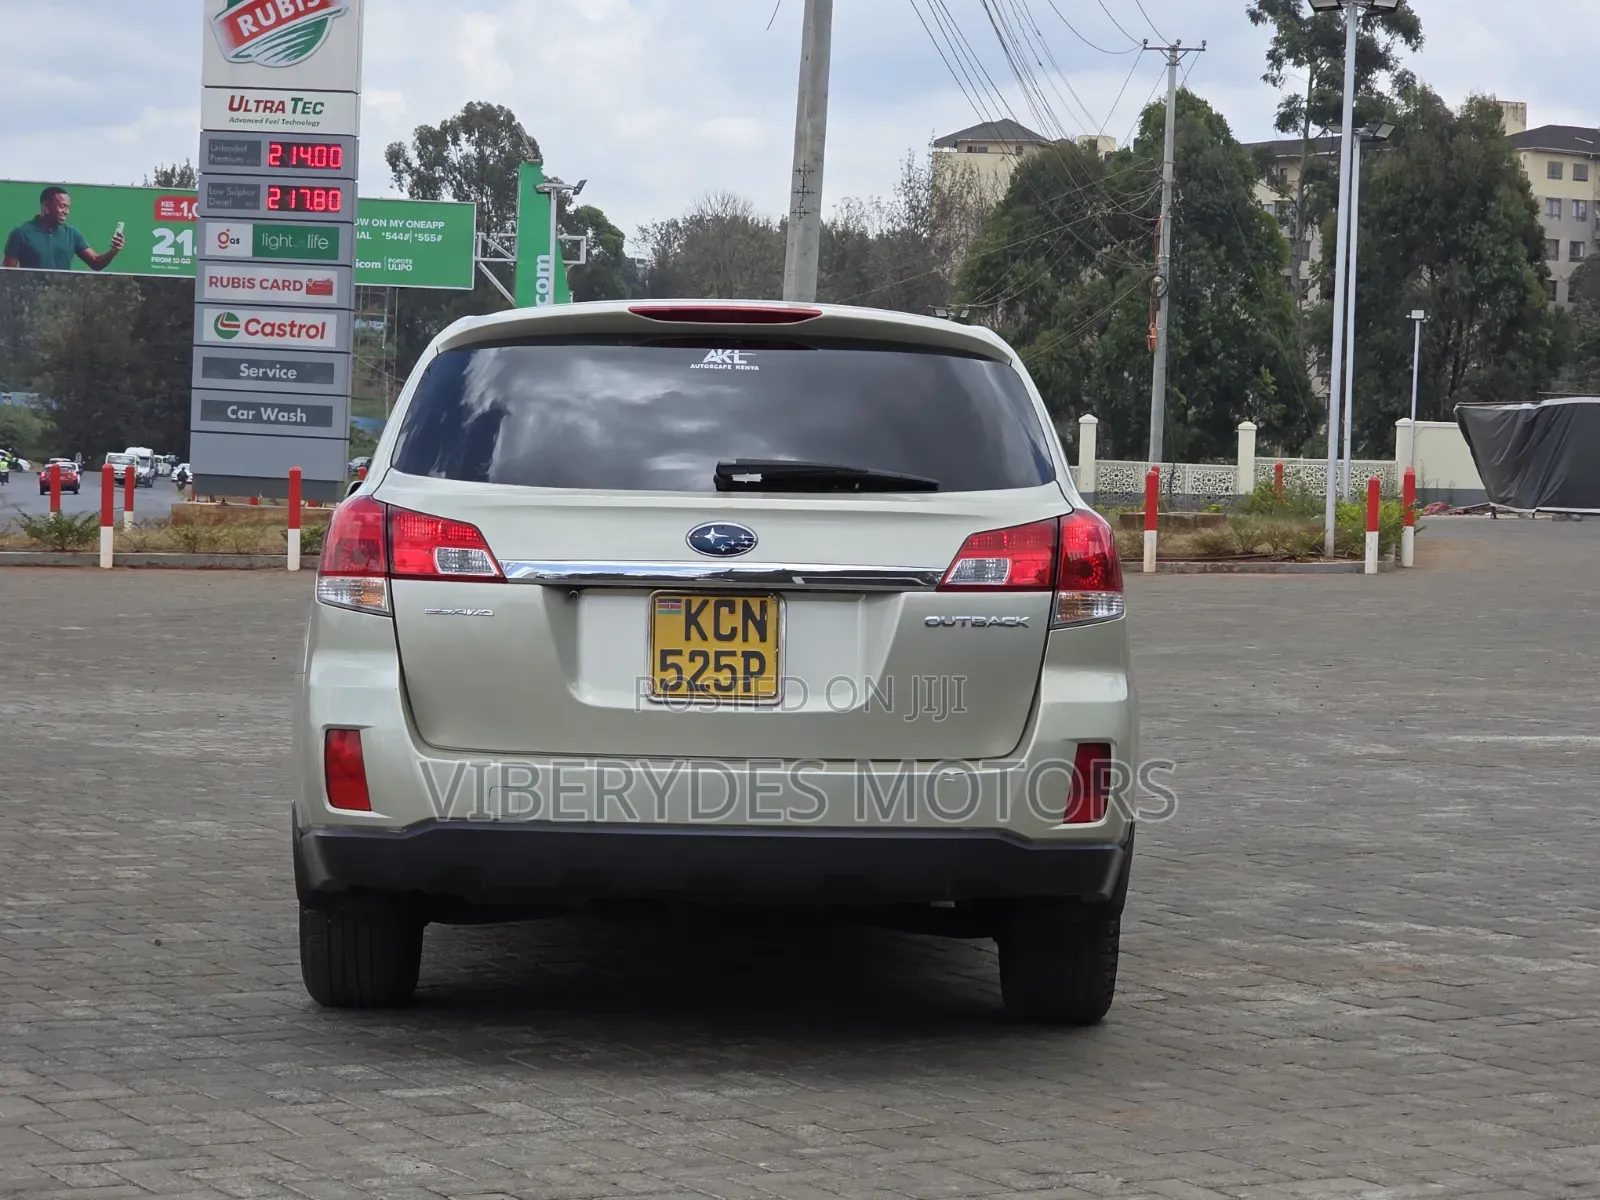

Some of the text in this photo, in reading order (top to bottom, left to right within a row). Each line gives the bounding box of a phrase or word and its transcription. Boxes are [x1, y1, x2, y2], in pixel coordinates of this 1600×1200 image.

[228, 116, 264, 124] Advanced
[282, 118, 320, 128] Technology
[210, 153, 244, 163] Premium
[269, 144, 343, 168] 214.00
[227, 187, 256, 199] Sulphur
[268, 188, 341, 211] 217.80
[161, 200, 174, 208] KES
[372, 218, 386, 226] ON
[390, 220, 404, 228] MY
[406, 220, 445, 229] ONEAPP
[262, 232, 293, 250] light
[307, 233, 329, 250] life
[151, 256, 172, 264] FROM
[388, 264, 412, 272] ULIPO
[259, 278, 303, 292] CARD
[244, 318, 326, 340] Castrol
[240, 363, 298, 379] Service
[227, 405, 307, 422] Car Wash
[684, 599, 768, 642] KCN
[924, 616, 1030, 628] OUTBACK
[660, 648, 766, 693] 525P
